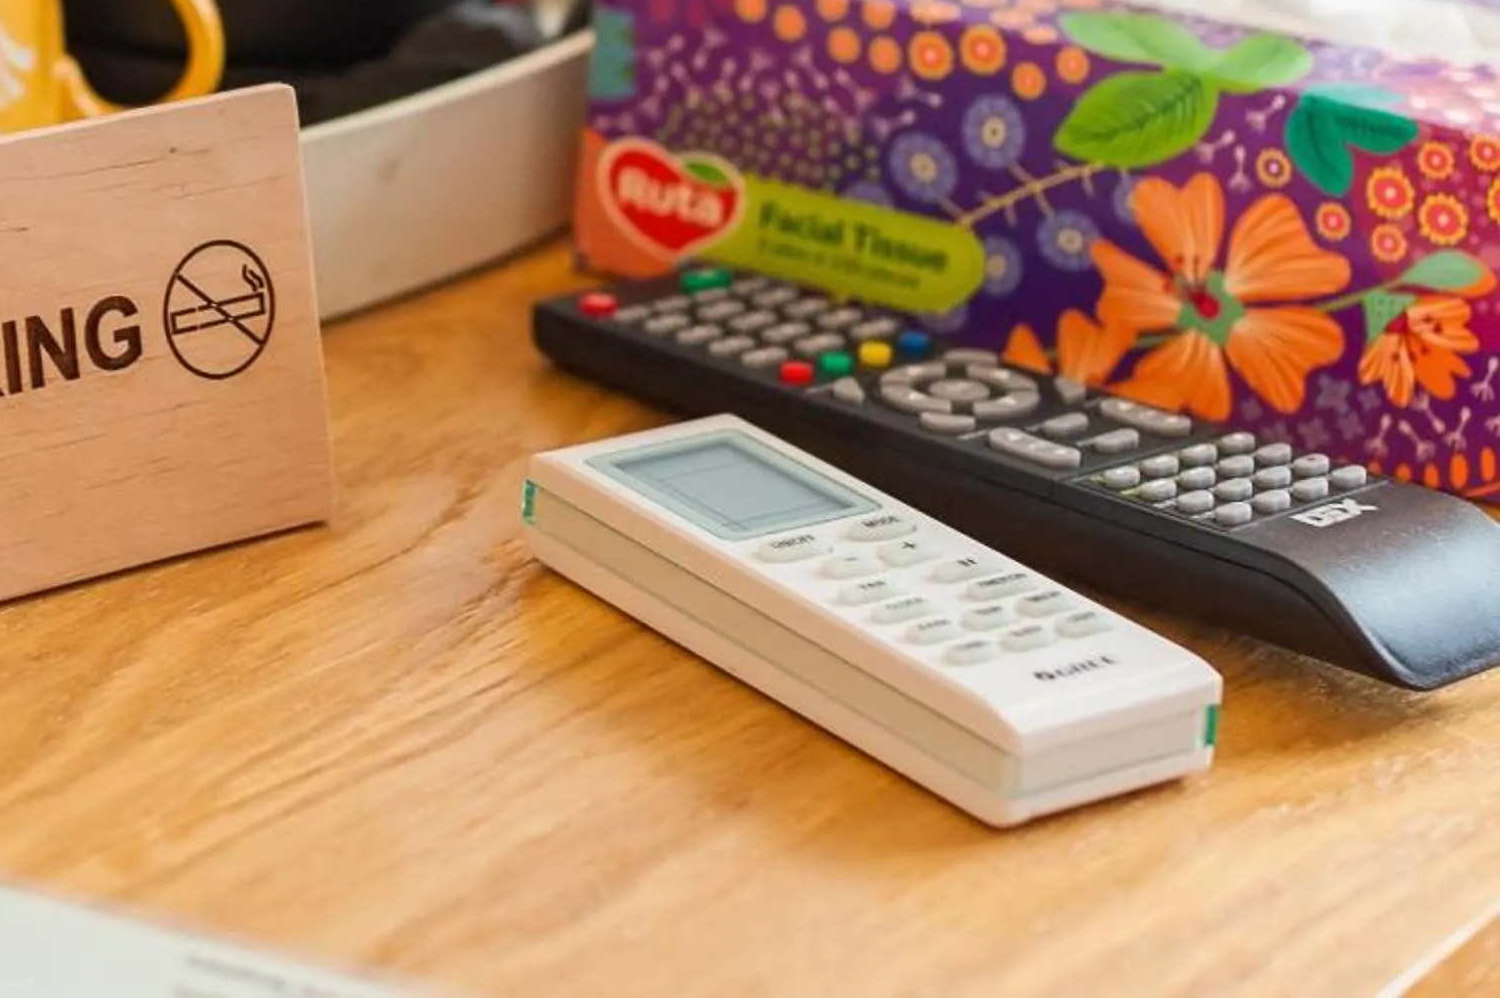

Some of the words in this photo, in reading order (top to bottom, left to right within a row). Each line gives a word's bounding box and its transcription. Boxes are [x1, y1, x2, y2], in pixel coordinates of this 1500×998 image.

[617, 166, 724, 228] Ruta
[760, 199, 845, 245] Facial
[853, 219, 949, 275] Tissue
